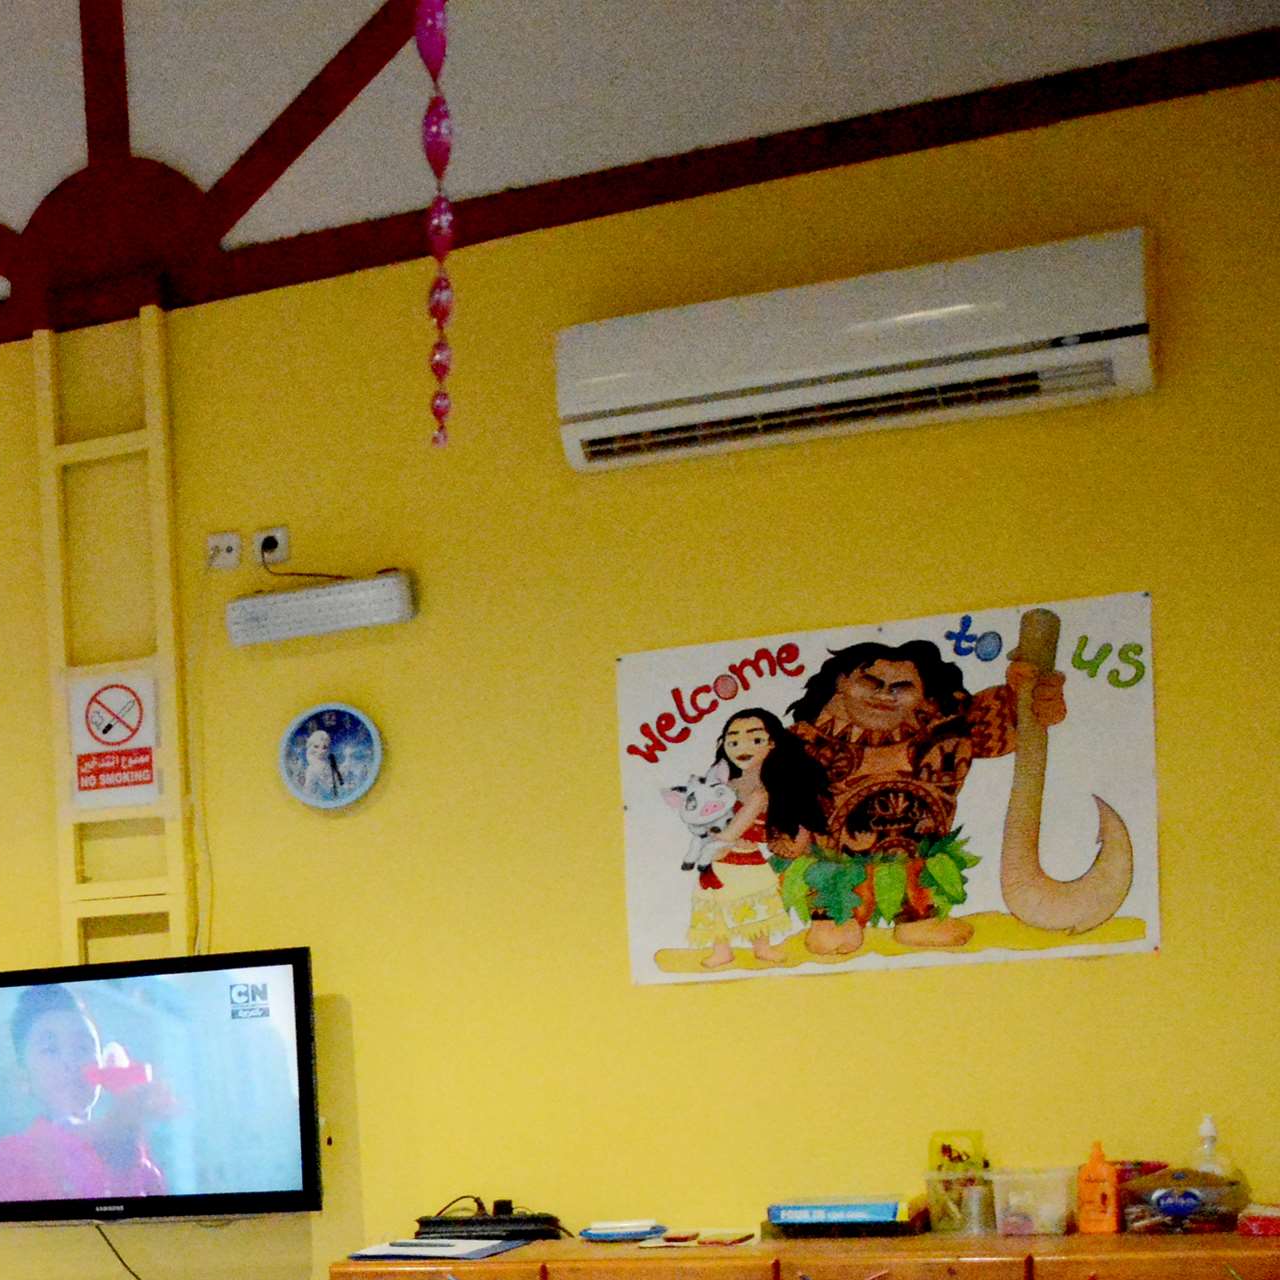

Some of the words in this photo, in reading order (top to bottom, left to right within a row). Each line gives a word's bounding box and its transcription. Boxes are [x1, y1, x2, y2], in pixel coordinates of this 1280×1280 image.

[944, 614, 1003, 662] to
[1071, 634, 1146, 689] us
[80, 775, 97, 788] NO
[99, 769, 151, 785] SMOKING
[229, 983, 268, 1004] CN
